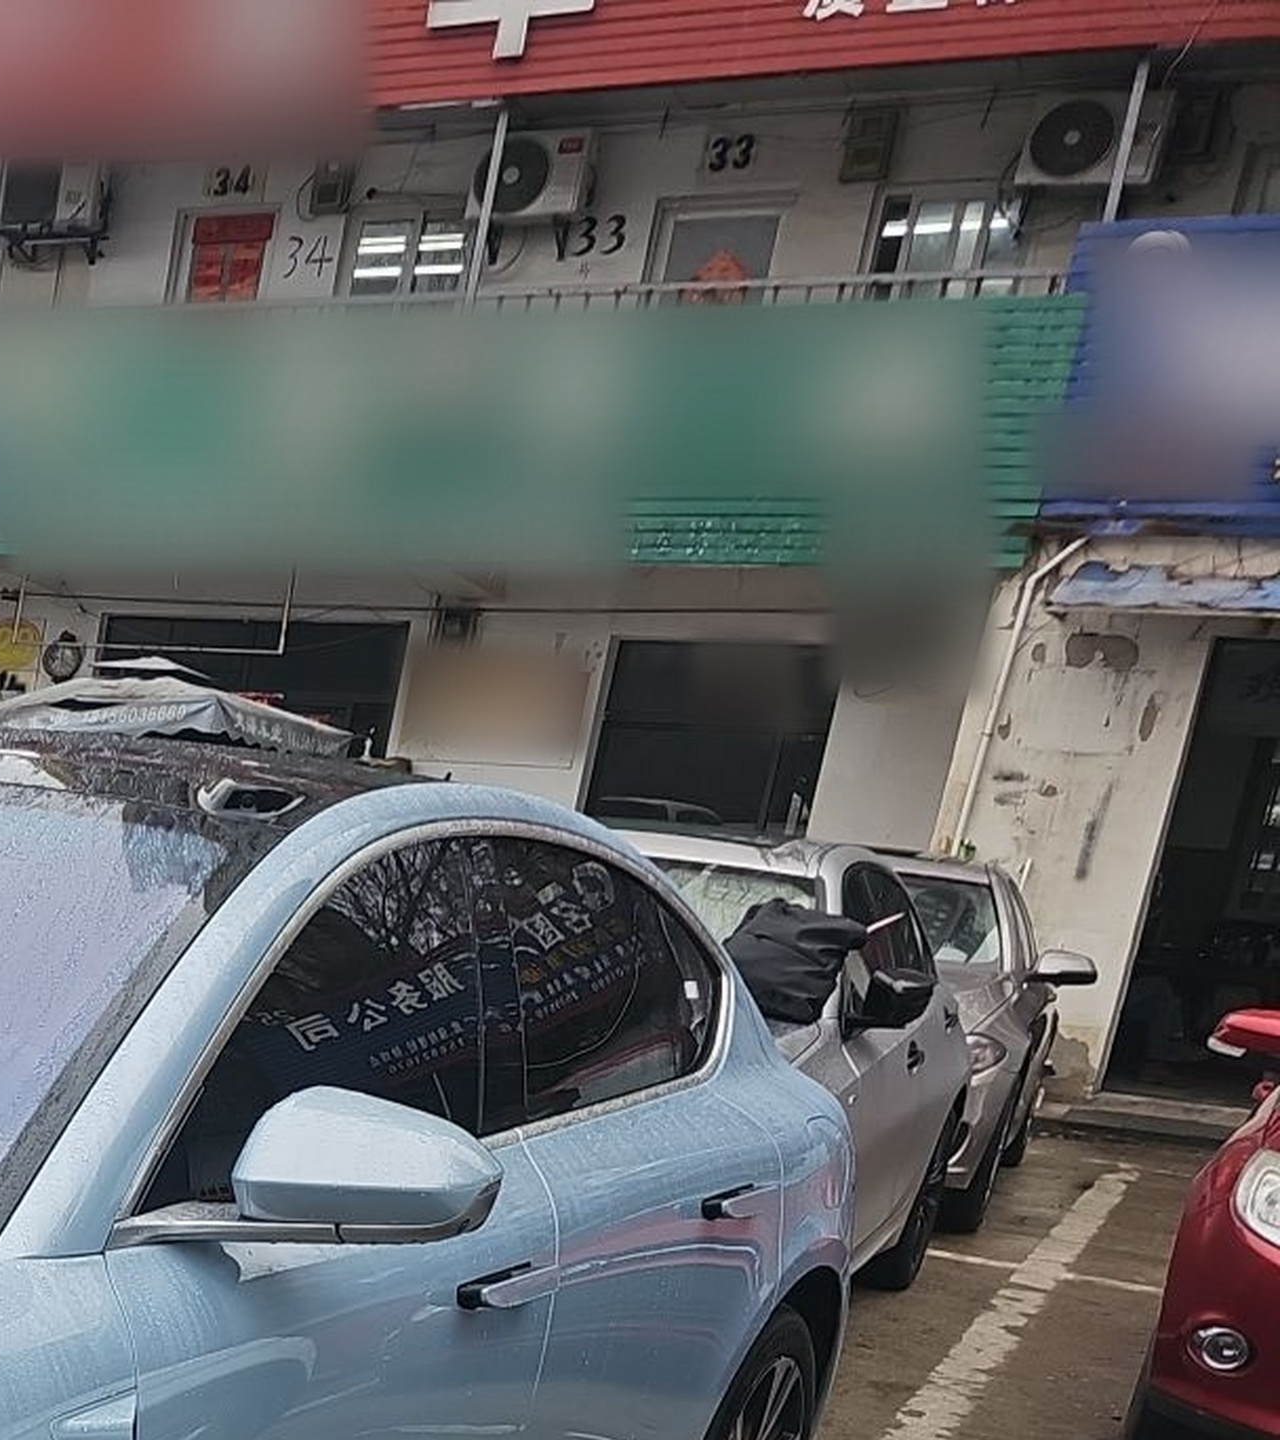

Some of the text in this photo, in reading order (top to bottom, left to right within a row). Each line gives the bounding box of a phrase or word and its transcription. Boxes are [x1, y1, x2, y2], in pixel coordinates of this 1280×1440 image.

[708, 134, 755, 171] 33
[212, 164, 252, 196] 34
[571, 214, 627, 257] 33
[283, 235, 334, 279] 34
